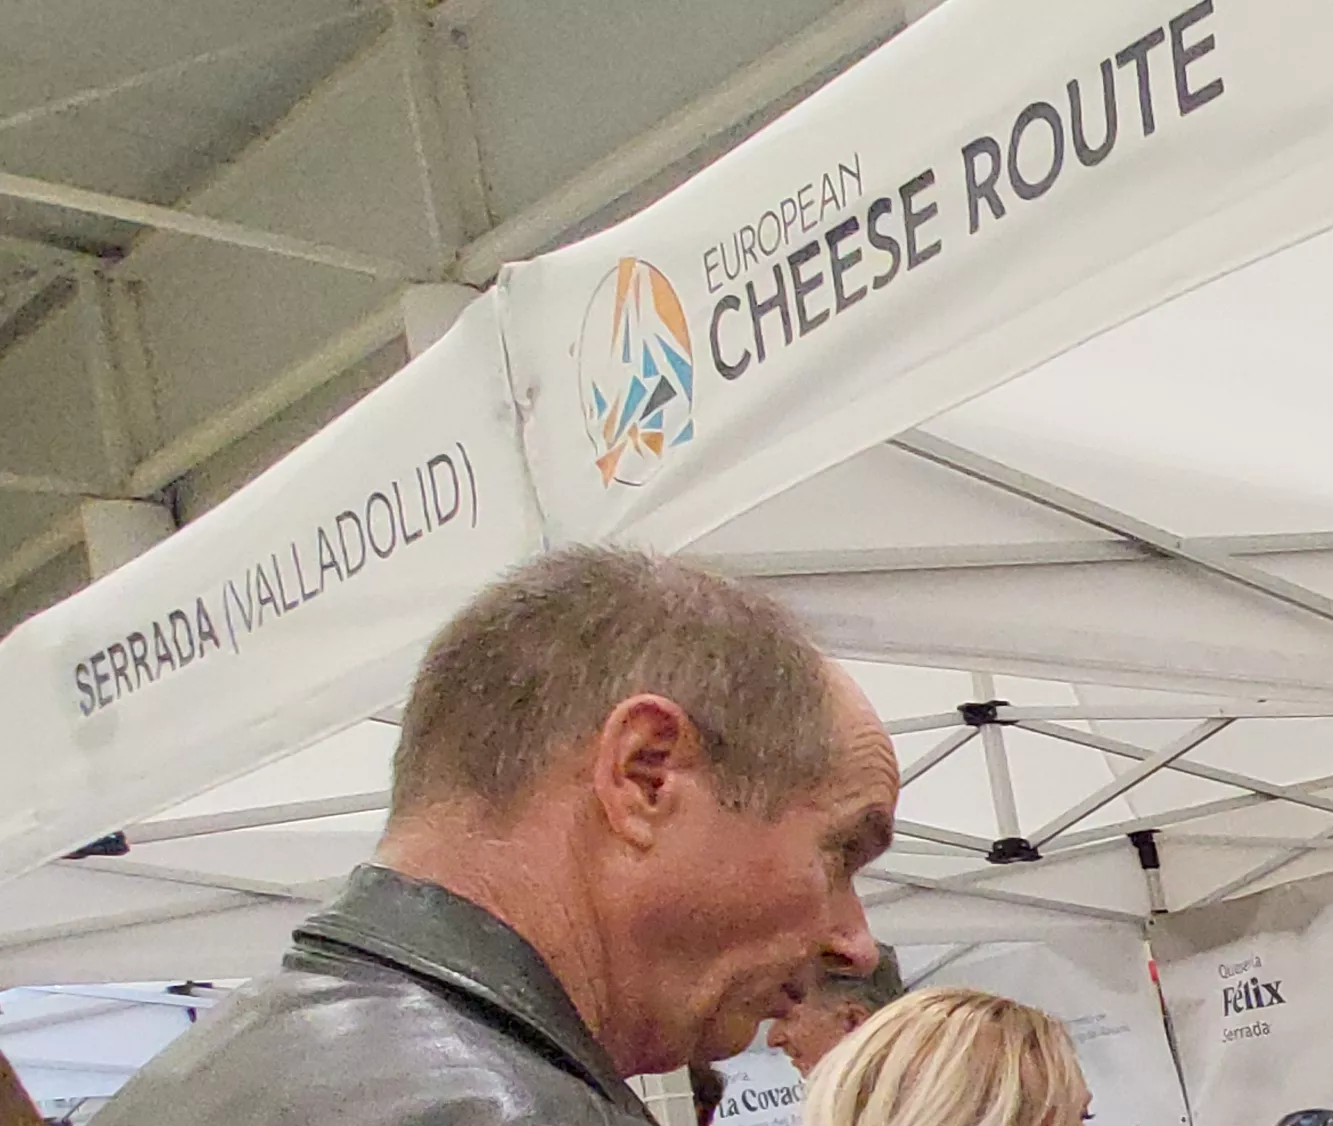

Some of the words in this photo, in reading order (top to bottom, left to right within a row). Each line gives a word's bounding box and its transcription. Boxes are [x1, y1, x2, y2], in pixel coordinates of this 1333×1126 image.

[704, 152, 863, 294] EUROPEAN
[709, 167, 943, 381] CHEESE
[961, 3, 1224, 236] ROUTE
[75, 597, 220, 716] SERRADA
[224, 442, 479, 655] (VALLADOLID)
[1223, 976, 1287, 1017] Félix
[720, 1098, 740, 1118] La
